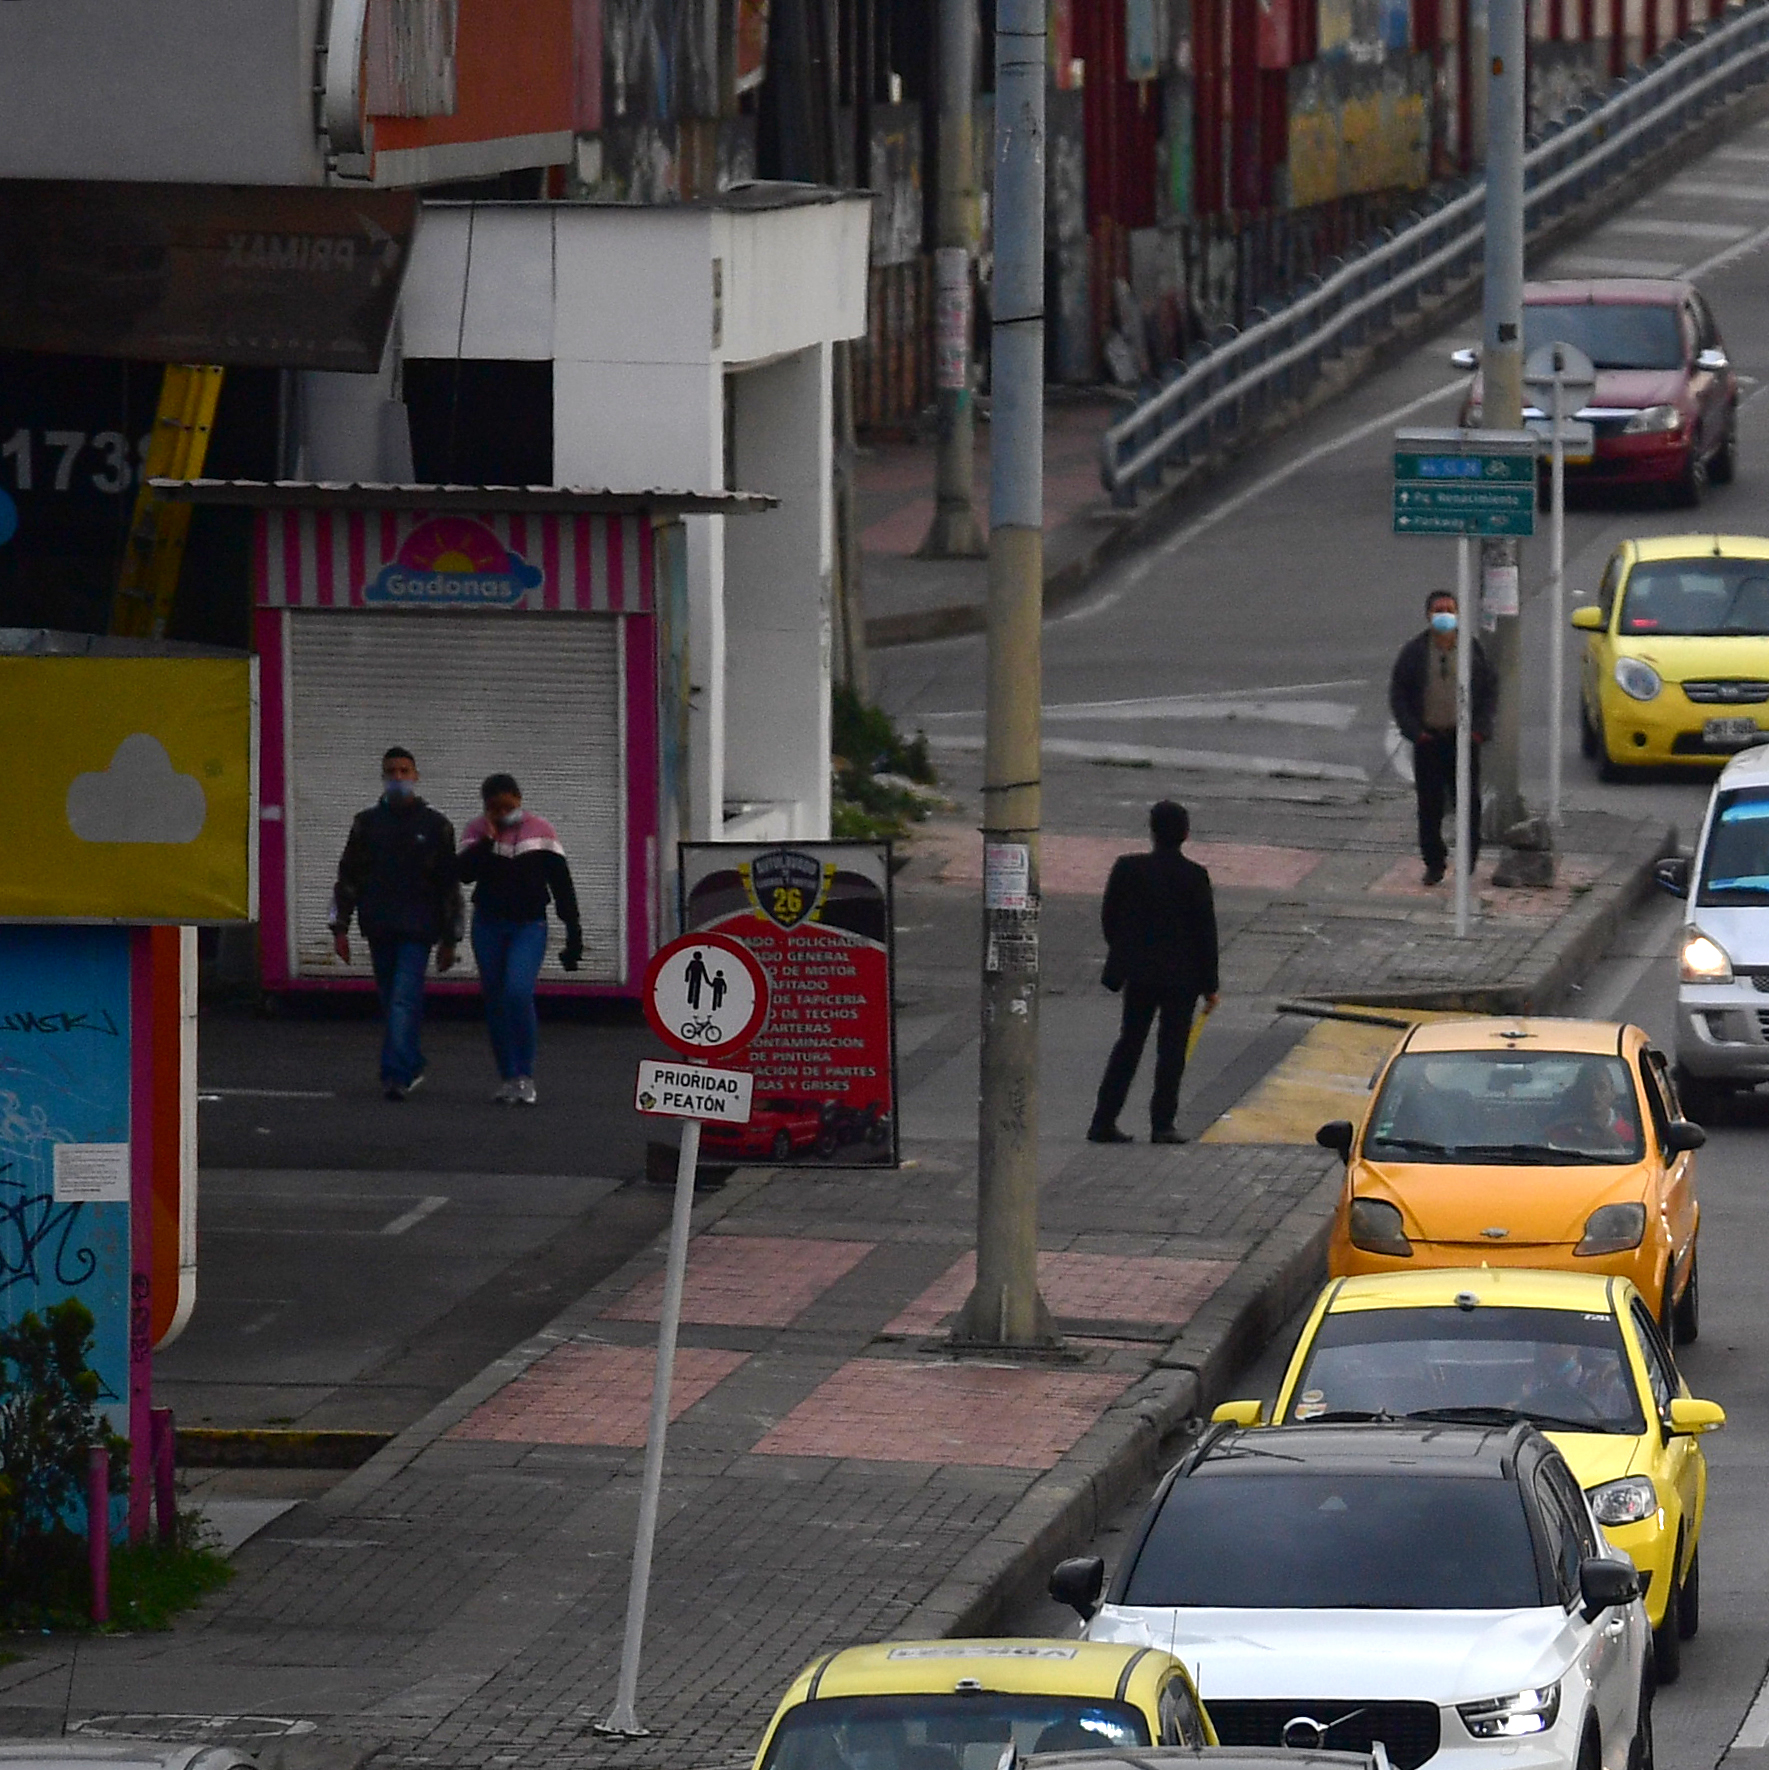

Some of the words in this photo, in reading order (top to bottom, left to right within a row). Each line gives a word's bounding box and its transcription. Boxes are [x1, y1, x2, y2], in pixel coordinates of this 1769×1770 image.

[2, 427, 152, 493] 173
[773, 887, 803, 912] 26
[787, 951, 849, 962] GENERAL
[805, 966, 857, 976] MOTOR
[805, 1009, 858, 1020] TECHOS
[654, 1070, 738, 1094] PRIORIDAD
[663, 1092, 726, 1113] PEATÓN
